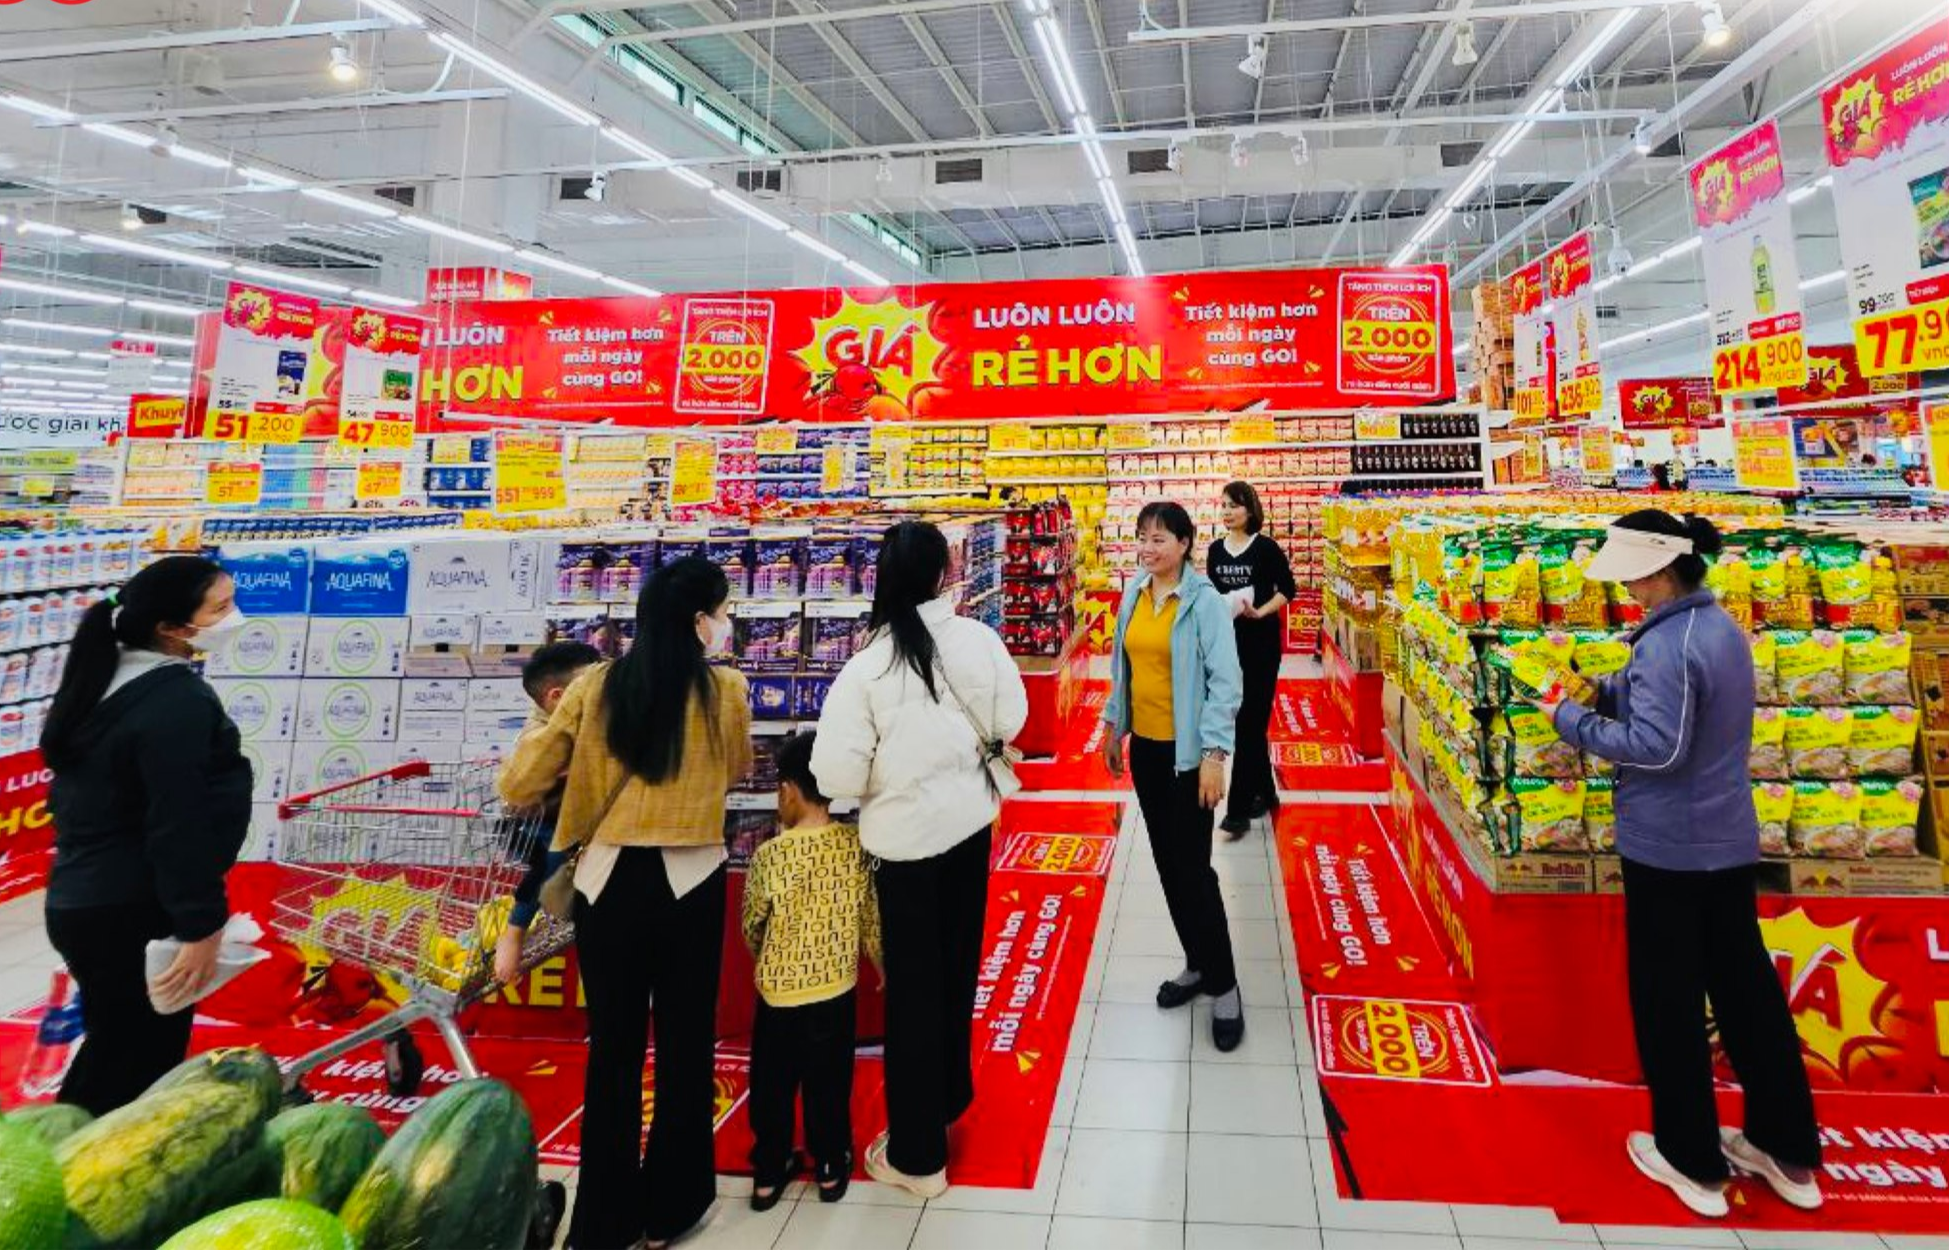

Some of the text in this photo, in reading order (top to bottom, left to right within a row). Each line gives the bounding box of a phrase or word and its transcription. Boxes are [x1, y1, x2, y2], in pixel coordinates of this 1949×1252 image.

[974, 298, 1136, 329] LUÔN LUÔN
[1184, 301, 1318, 321] Tiết kiệm hơn
[1368, 302, 1411, 320] TRÊN
[435, 321, 505, 347] LUÔN
[546, 326, 664, 345] Tiết kiệm hơn
[1205, 324, 1297, 344] mỗi ngày
[1346, 326, 1432, 350] 2.000
[562, 346, 642, 365] mỗi ngày
[686, 348, 762, 370] 2.000
[822, 320, 923, 378] GIÁ
[972, 334, 1163, 387] RẺ HƠN
[1207, 351, 1256, 367] cùng
[421, 363, 524, 402] HƠN
[562, 368, 643, 389] cùng GO!
[231, 570, 293, 592] AQUAFINA
[325, 570, 395, 592] AQUAFINA
[427, 569, 491, 589] AQUAFINA
[1328, 898, 1354, 933] cùng
[1340, 935, 1369, 966] GO!
[989, 1012, 1023, 1052] mỗi
[1009, 962, 1043, 1008] ngày
[1026, 922, 1057, 960] cùng
[1371, 1004, 1411, 1073] 2.000
[1412, 1021, 1438, 1059] TRÊN
[1822, 1158, 1948, 1189] ngày
